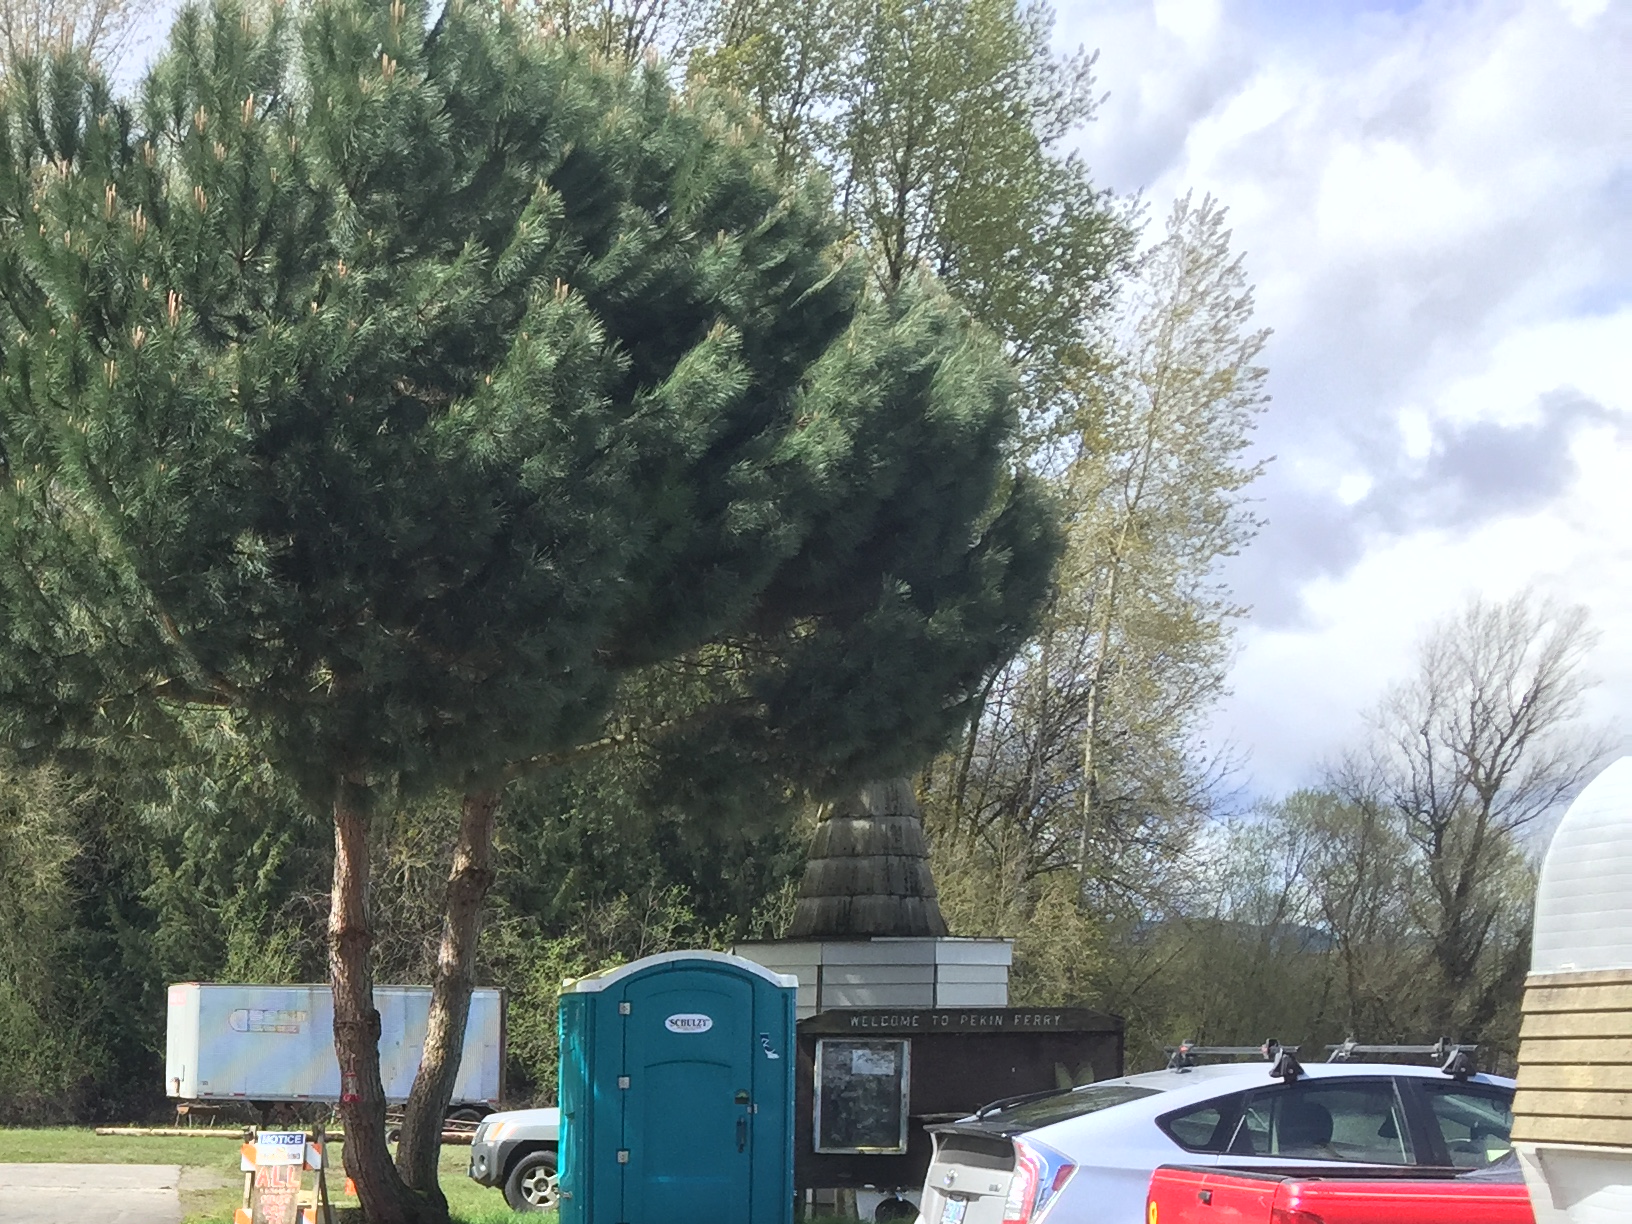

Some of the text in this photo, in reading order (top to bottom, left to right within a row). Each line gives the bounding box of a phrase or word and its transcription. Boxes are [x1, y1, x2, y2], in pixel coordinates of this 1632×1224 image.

[850, 1014, 1062, 1027] WELCOME TO PEKIN FERRY
[261, 1134, 302, 1145] NOTICE
[254, 1165, 301, 1188] ALL
